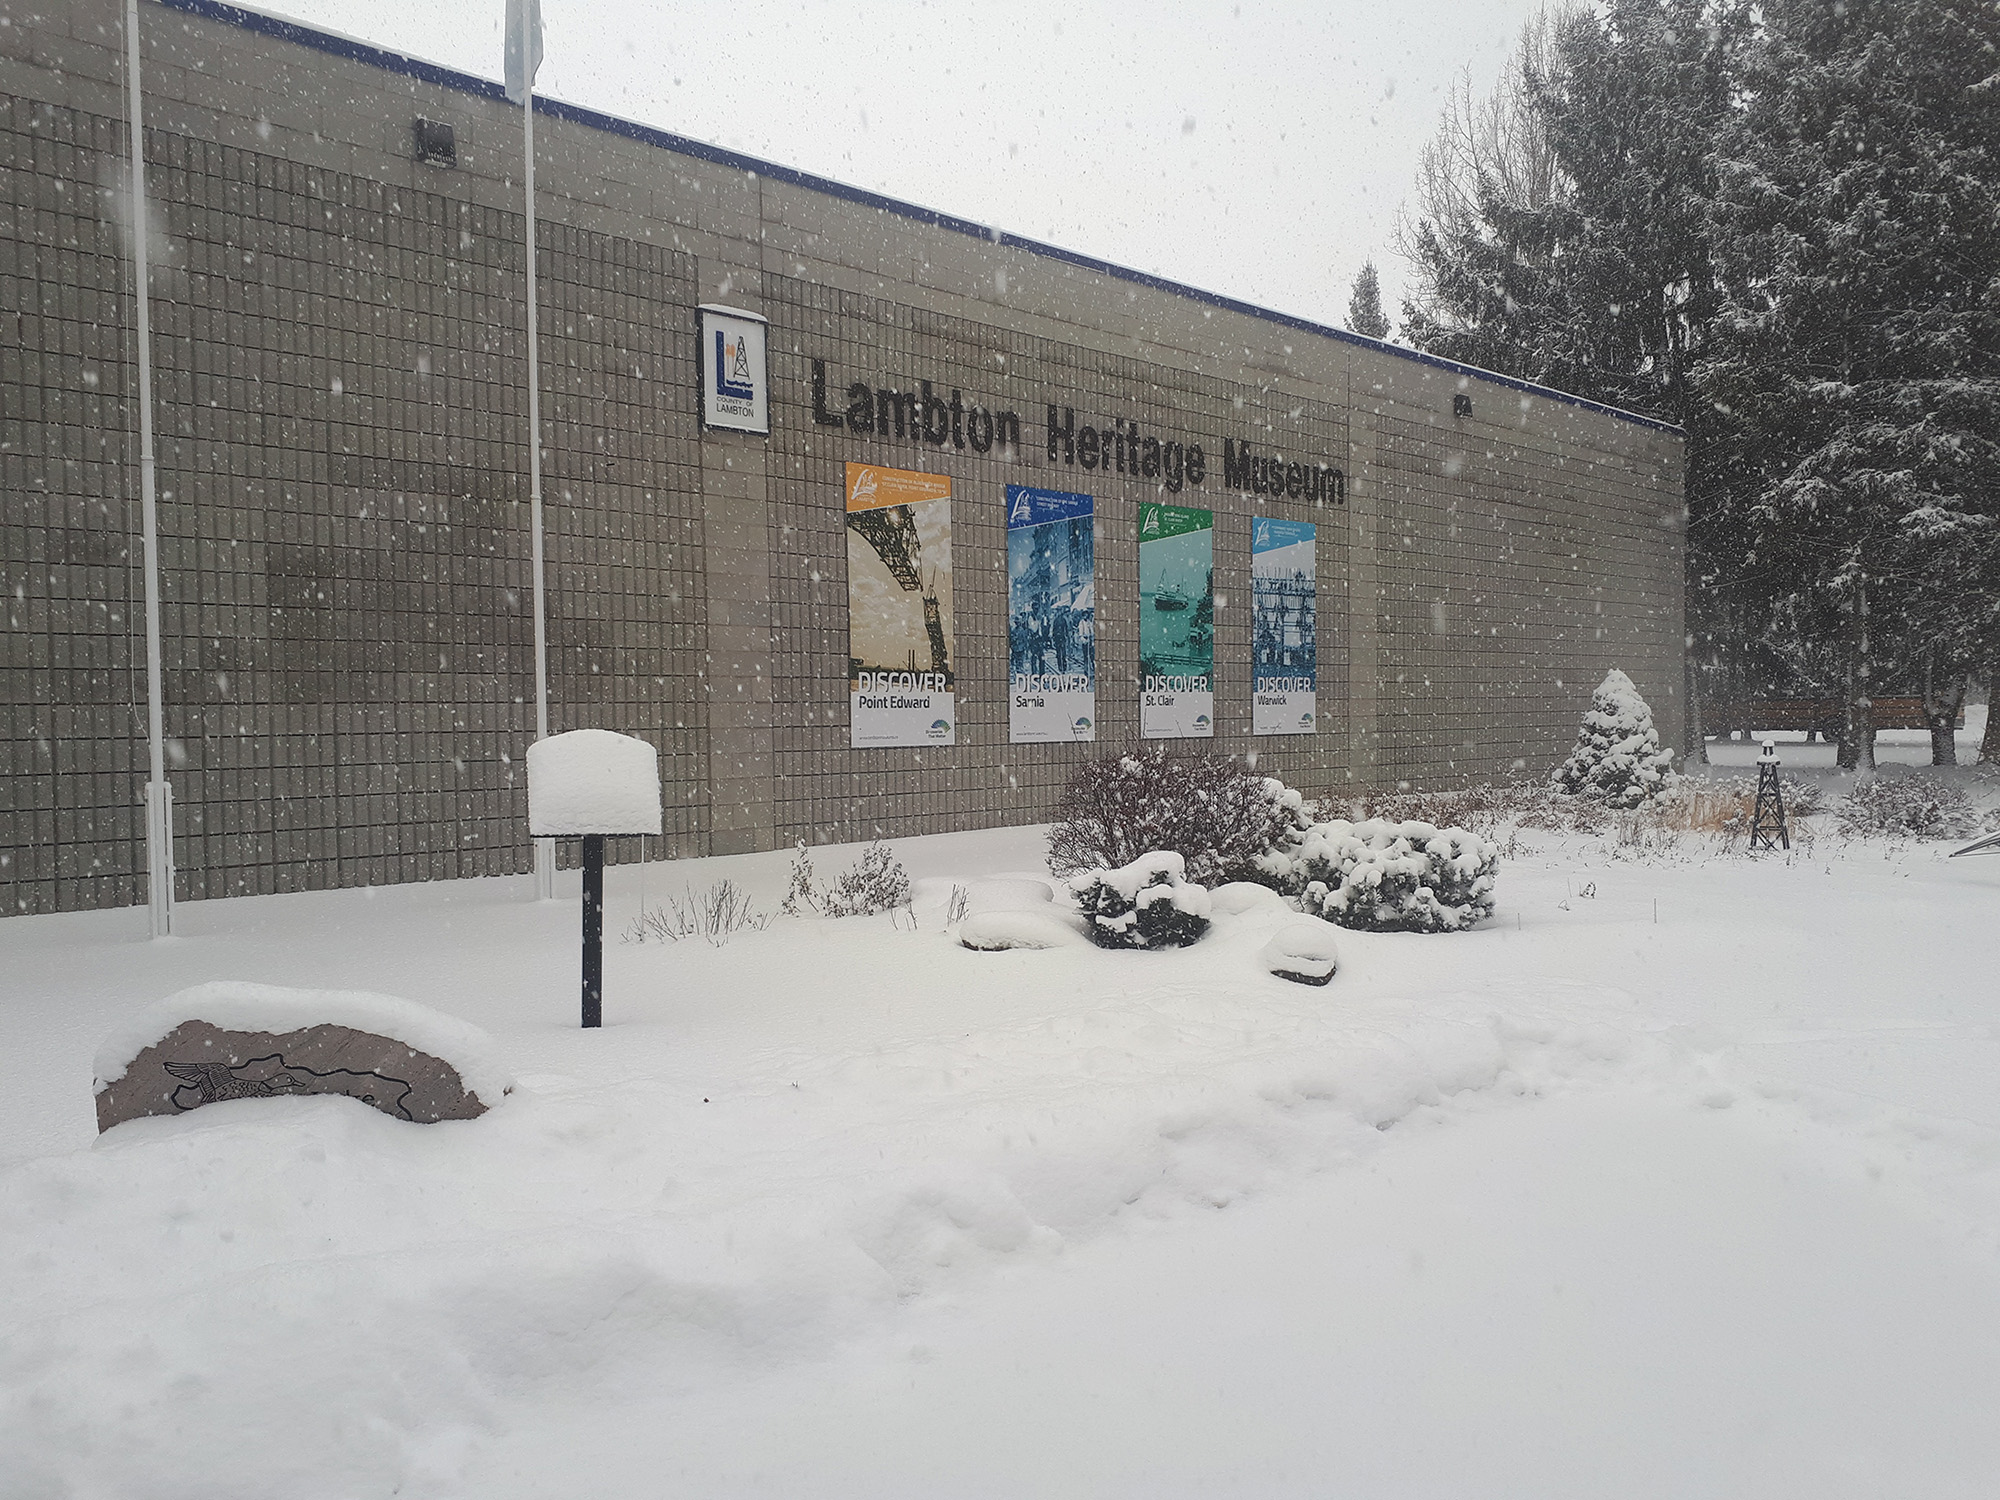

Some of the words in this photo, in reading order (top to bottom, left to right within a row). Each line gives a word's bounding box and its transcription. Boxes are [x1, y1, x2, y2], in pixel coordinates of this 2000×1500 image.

[717, 397, 743, 406] COUNTY
[746, 399, 753, 407] OF
[716, 403, 754, 417] LAMBTON
[812, 358, 1020, 455] Lambton
[1047, 404, 1206, 494] Heritage
[1223, 437, 1345, 504] Museum
[858, 671, 947, 693] DISCOVER
[1015, 673, 1089, 693] DISCOVER
[1145, 675, 1208, 693] DISCOVER
[1257, 676, 1312, 693] DISCOVER
[858, 695, 888, 709] Point
[890, 695, 931, 709] Edward
[1015, 695, 1045, 708] Sarnia
[1145, 695, 1157, 707] St.
[1158, 695, 1175, 707] Clair
[1257, 695, 1288, 706] Warwick
